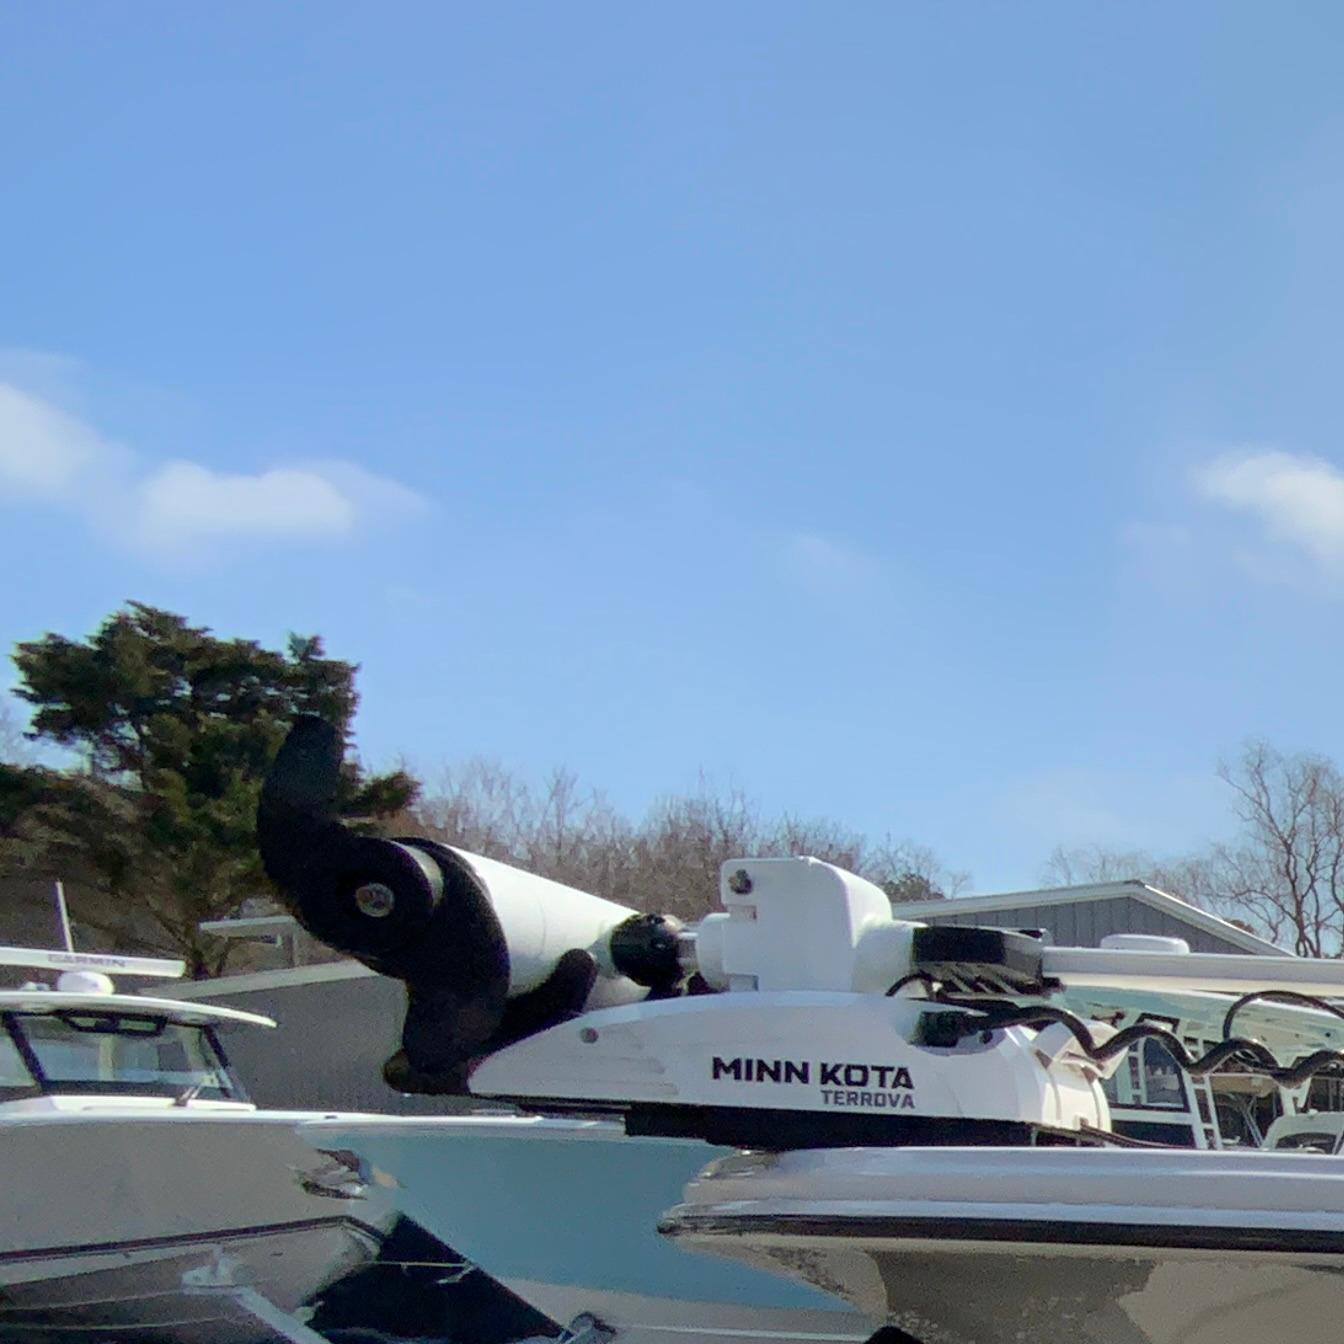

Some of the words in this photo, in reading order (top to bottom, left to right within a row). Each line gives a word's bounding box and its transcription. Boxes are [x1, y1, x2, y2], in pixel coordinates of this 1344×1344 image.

[712, 1056, 809, 1085] MINN
[819, 1062, 915, 1090] KOTA
[821, 1088, 916, 1110] TERROVA
